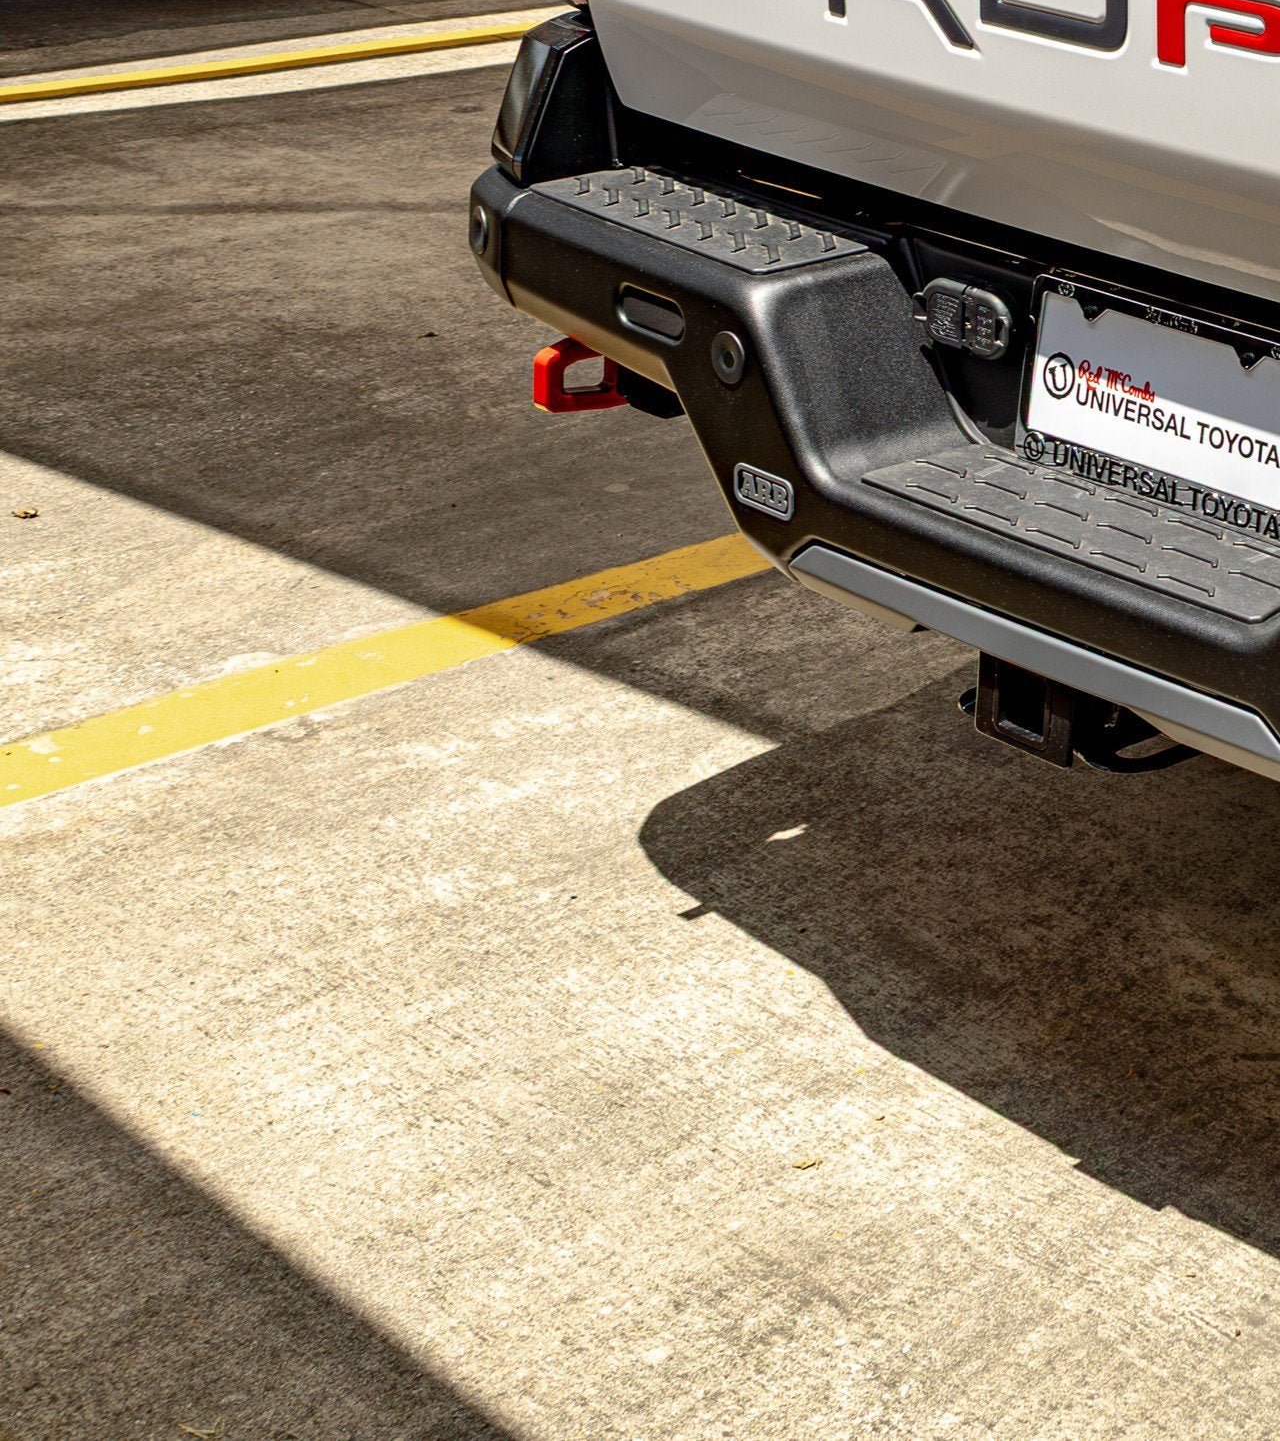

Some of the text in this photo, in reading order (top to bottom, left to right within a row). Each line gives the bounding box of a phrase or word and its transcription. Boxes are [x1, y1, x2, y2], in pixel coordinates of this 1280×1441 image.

[1078, 359, 1155, 403] Red McCombs
[1076, 383, 1280, 469] UNIVERSAL TOYOTA
[740, 471, 788, 512] ARB
[1052, 440, 1185, 507] UNIVERSAL
